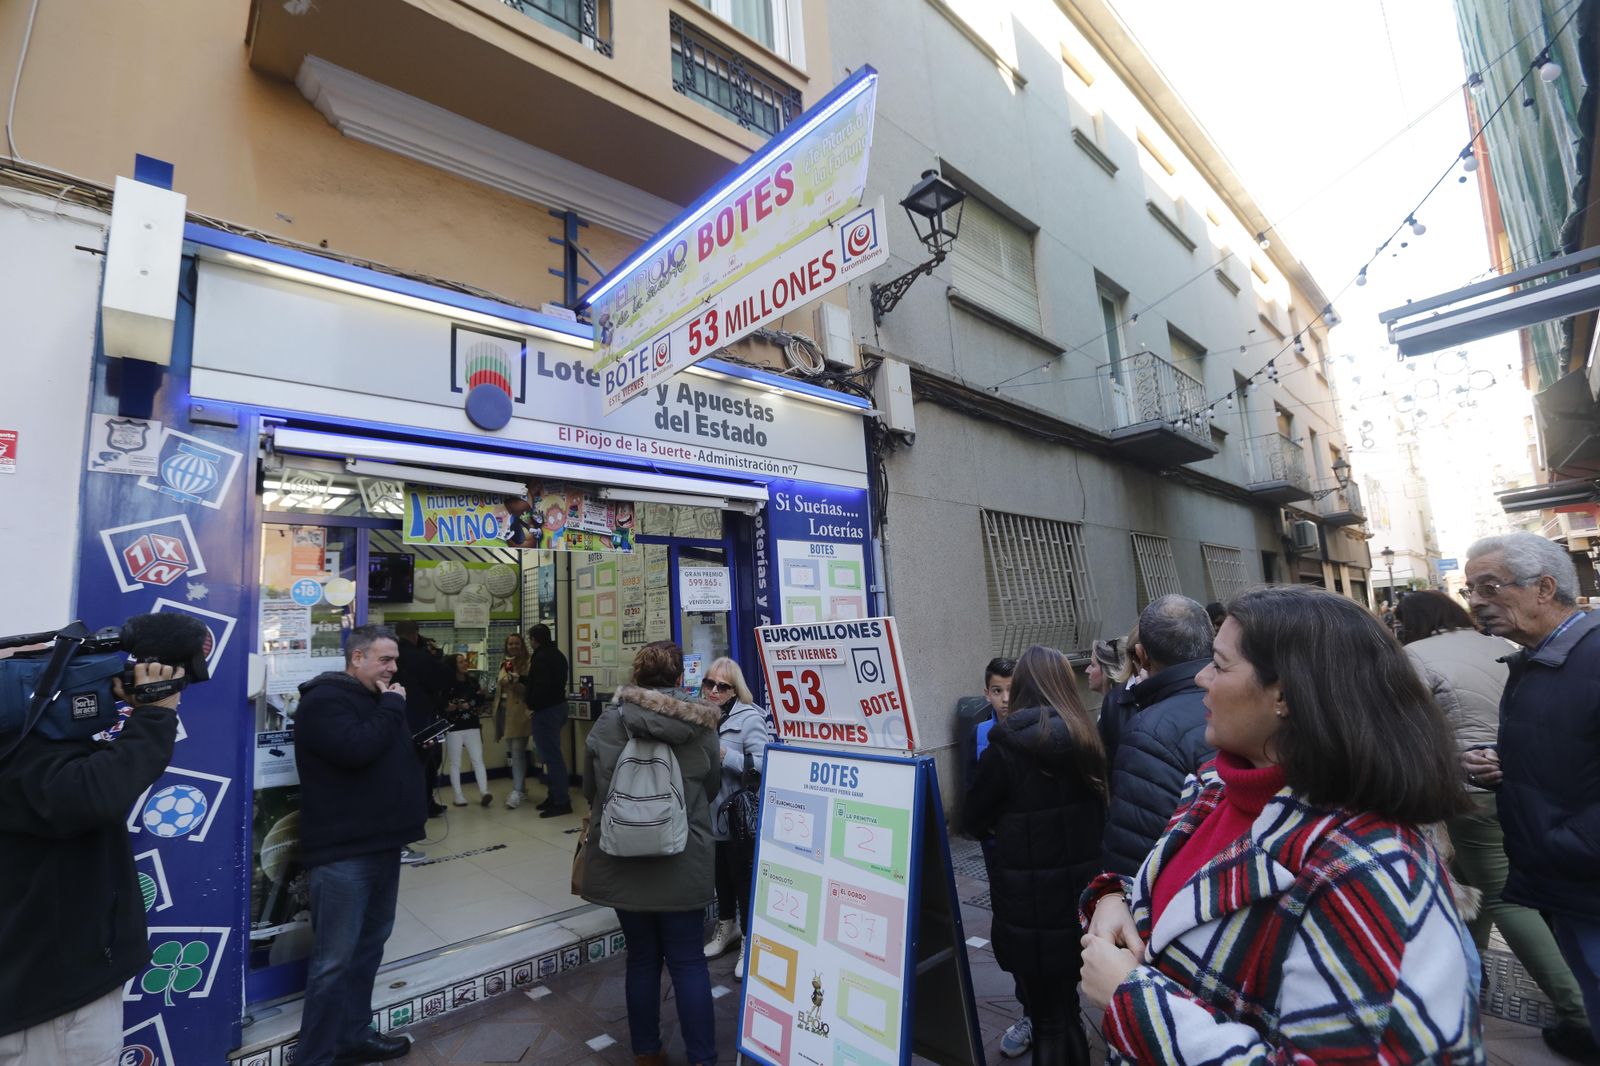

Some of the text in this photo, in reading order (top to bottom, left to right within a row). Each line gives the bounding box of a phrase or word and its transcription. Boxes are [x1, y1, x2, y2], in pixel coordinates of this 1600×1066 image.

[698, 162, 794, 262] BOTES
[840, 247, 883, 275] Euromillones
[688, 249, 837, 356] 53 MILLONES
[606, 346, 649, 396] BOTE
[537, 351, 774, 422] Lote y Apuestas
[609, 376, 645, 407] ESTE VIERNES
[654, 406, 767, 447] del Estado
[558, 426, 571, 441] El
[575, 429, 612, 449] Piojo
[615, 436, 632, 450] de
[636, 438, 647, 453] la
[651, 441, 691, 459] Suerte
[775, 492, 790, 511] Si
[438, 507, 499, 544] NIÑO
[809, 518, 864, 539] Loterías
[755, 515, 768, 590] oterías
[810, 544, 834, 555] BOTES
[757, 595, 768, 608] y
[762, 621, 882, 643] EUROMILLONES
[776, 648, 837, 661] ESTE VIERNES
[776, 669, 826, 716] 53
[860, 691, 900, 717] BOTE
[783, 720, 868, 744] MILLONES
[810, 761, 859, 789] BOTES
[776, 799, 806, 811] EUROMILLONES
[853, 814, 878, 824] PRIMITIVA
[848, 890, 867, 901] GORDO
